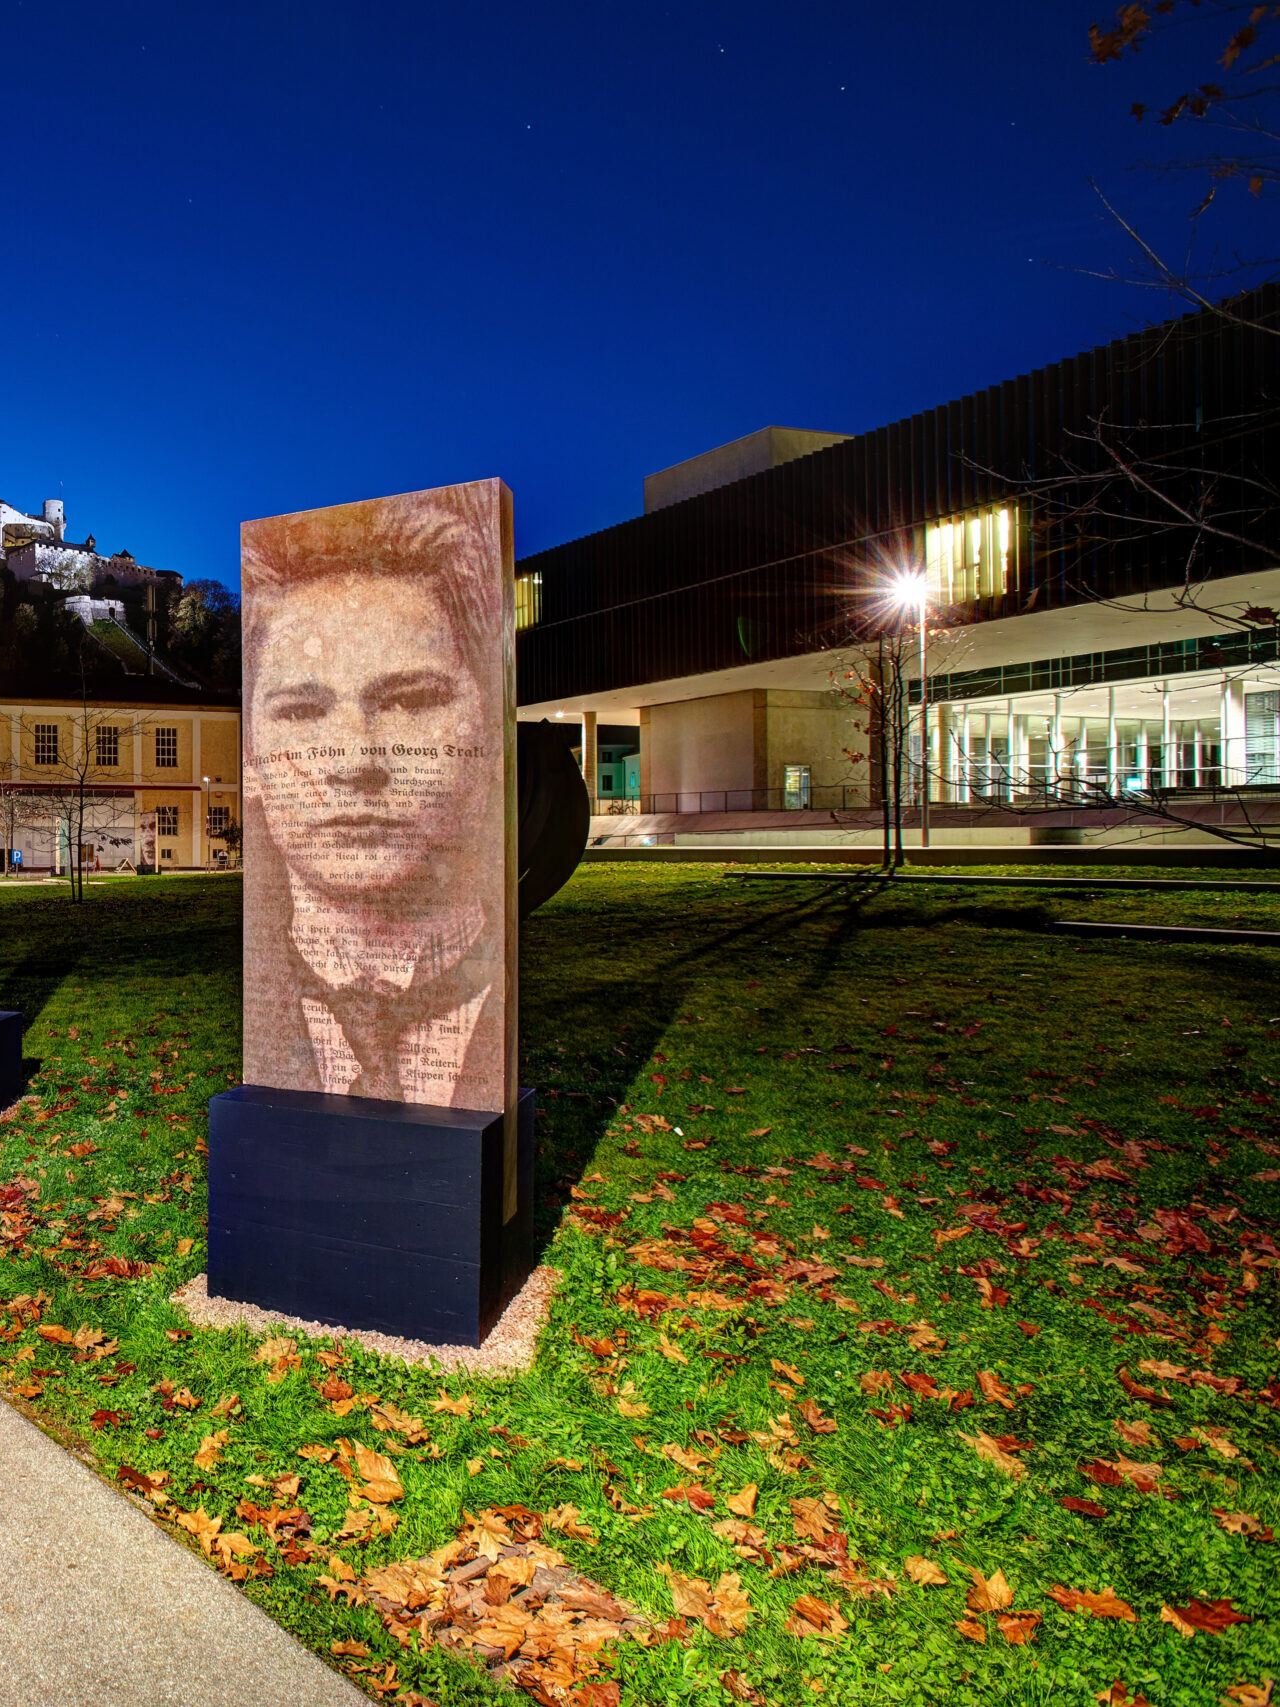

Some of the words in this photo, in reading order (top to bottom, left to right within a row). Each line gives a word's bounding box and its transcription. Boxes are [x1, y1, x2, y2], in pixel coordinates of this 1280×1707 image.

[286, 751, 302, 761] im
[306, 746, 346, 761] Föhn
[360, 746, 387, 756] von
[391, 744, 438, 759] Georg
[443, 744, 485, 758] Trakl
[318, 767, 331, 775] die
[390, 766, 408, 774] und
[415, 766, 445, 776] braun,
[394, 777, 445, 787] durchzogen.
[299, 801, 331, 810] flattern
[337, 800, 357, 808] über
[363, 799, 390, 809] Busch
[395, 800, 413, 808] und
[14, 850, 23, 862] P
[305, 893, 322, 903] Zug
[316, 905, 331, 914] der
[342, 938, 359, 947] den
[333, 961, 347, 970] die
[413, 1023, 433, 1033] und
[439, 1025, 463, 1035] sinkt.
[404, 1043, 441, 1056] Alleen,
[420, 1057, 460, 1069] Reitern.
[332, 1064, 347, 1072] ein
[405, 1068, 444, 1081] Klippen
